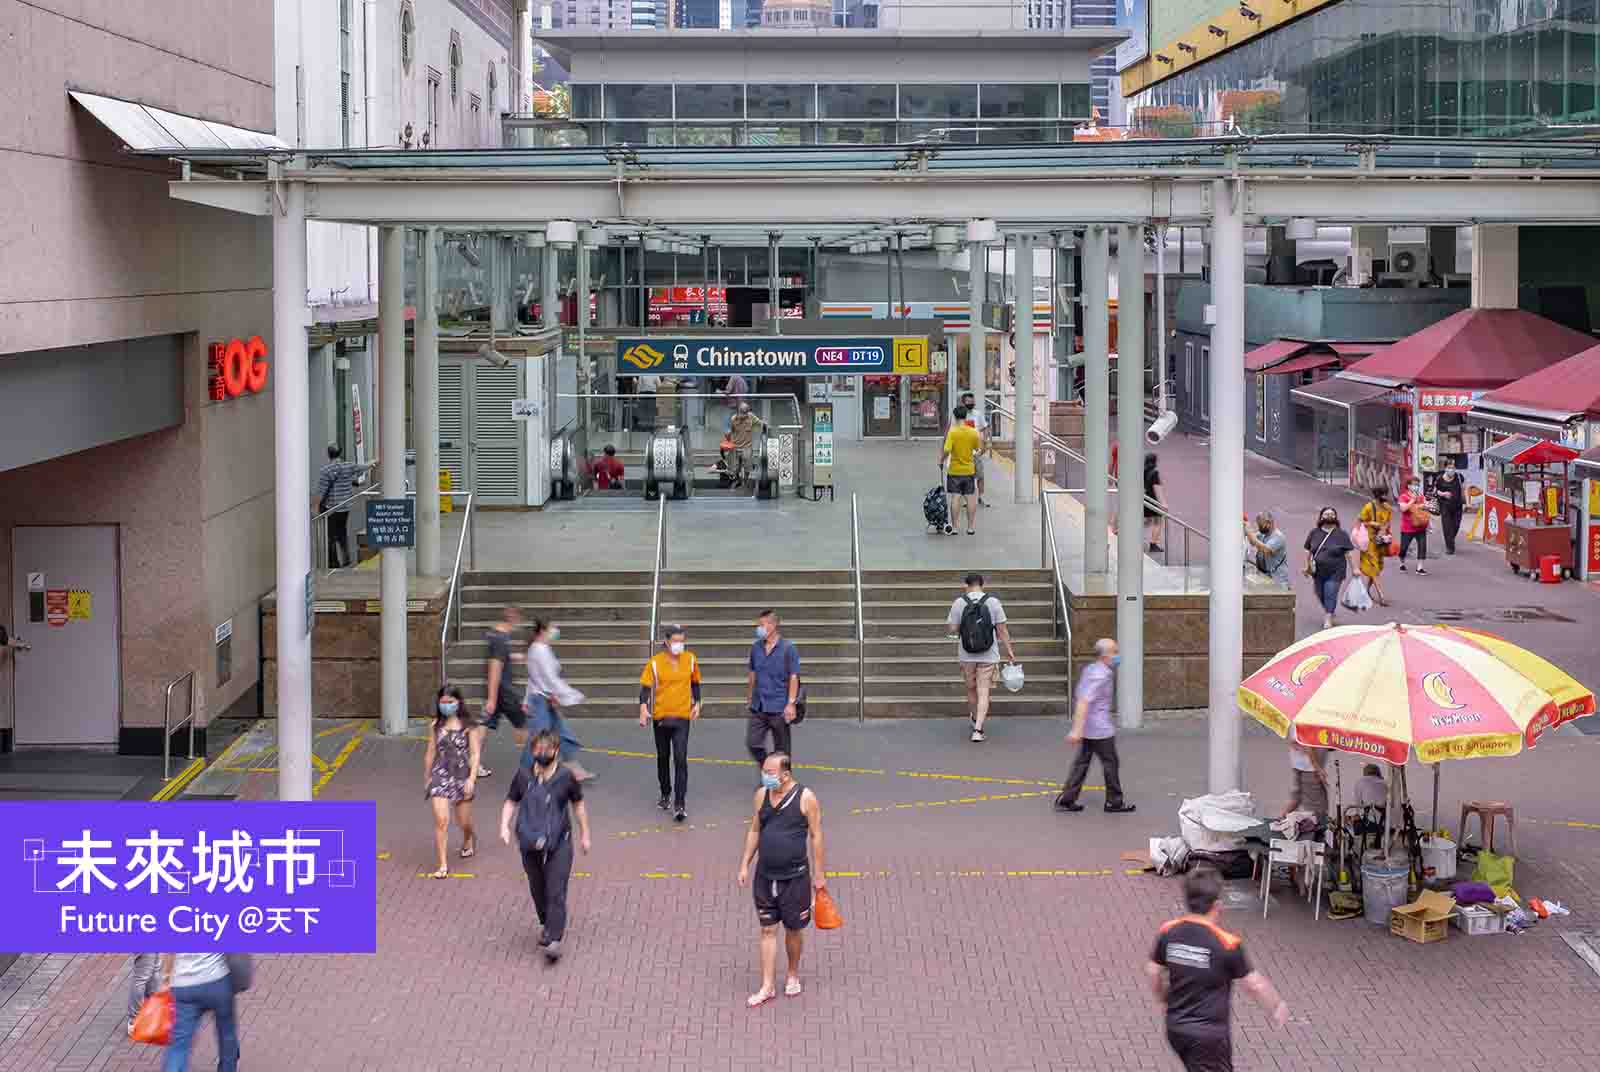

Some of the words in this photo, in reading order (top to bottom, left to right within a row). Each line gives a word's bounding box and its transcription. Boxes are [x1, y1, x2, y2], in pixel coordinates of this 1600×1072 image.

[225, 336, 268, 396] OG
[696, 346, 807, 367] Chinatown
[822, 351, 843, 361] NE4
[852, 351, 880, 361] DT19
[905, 348, 918, 362] C
